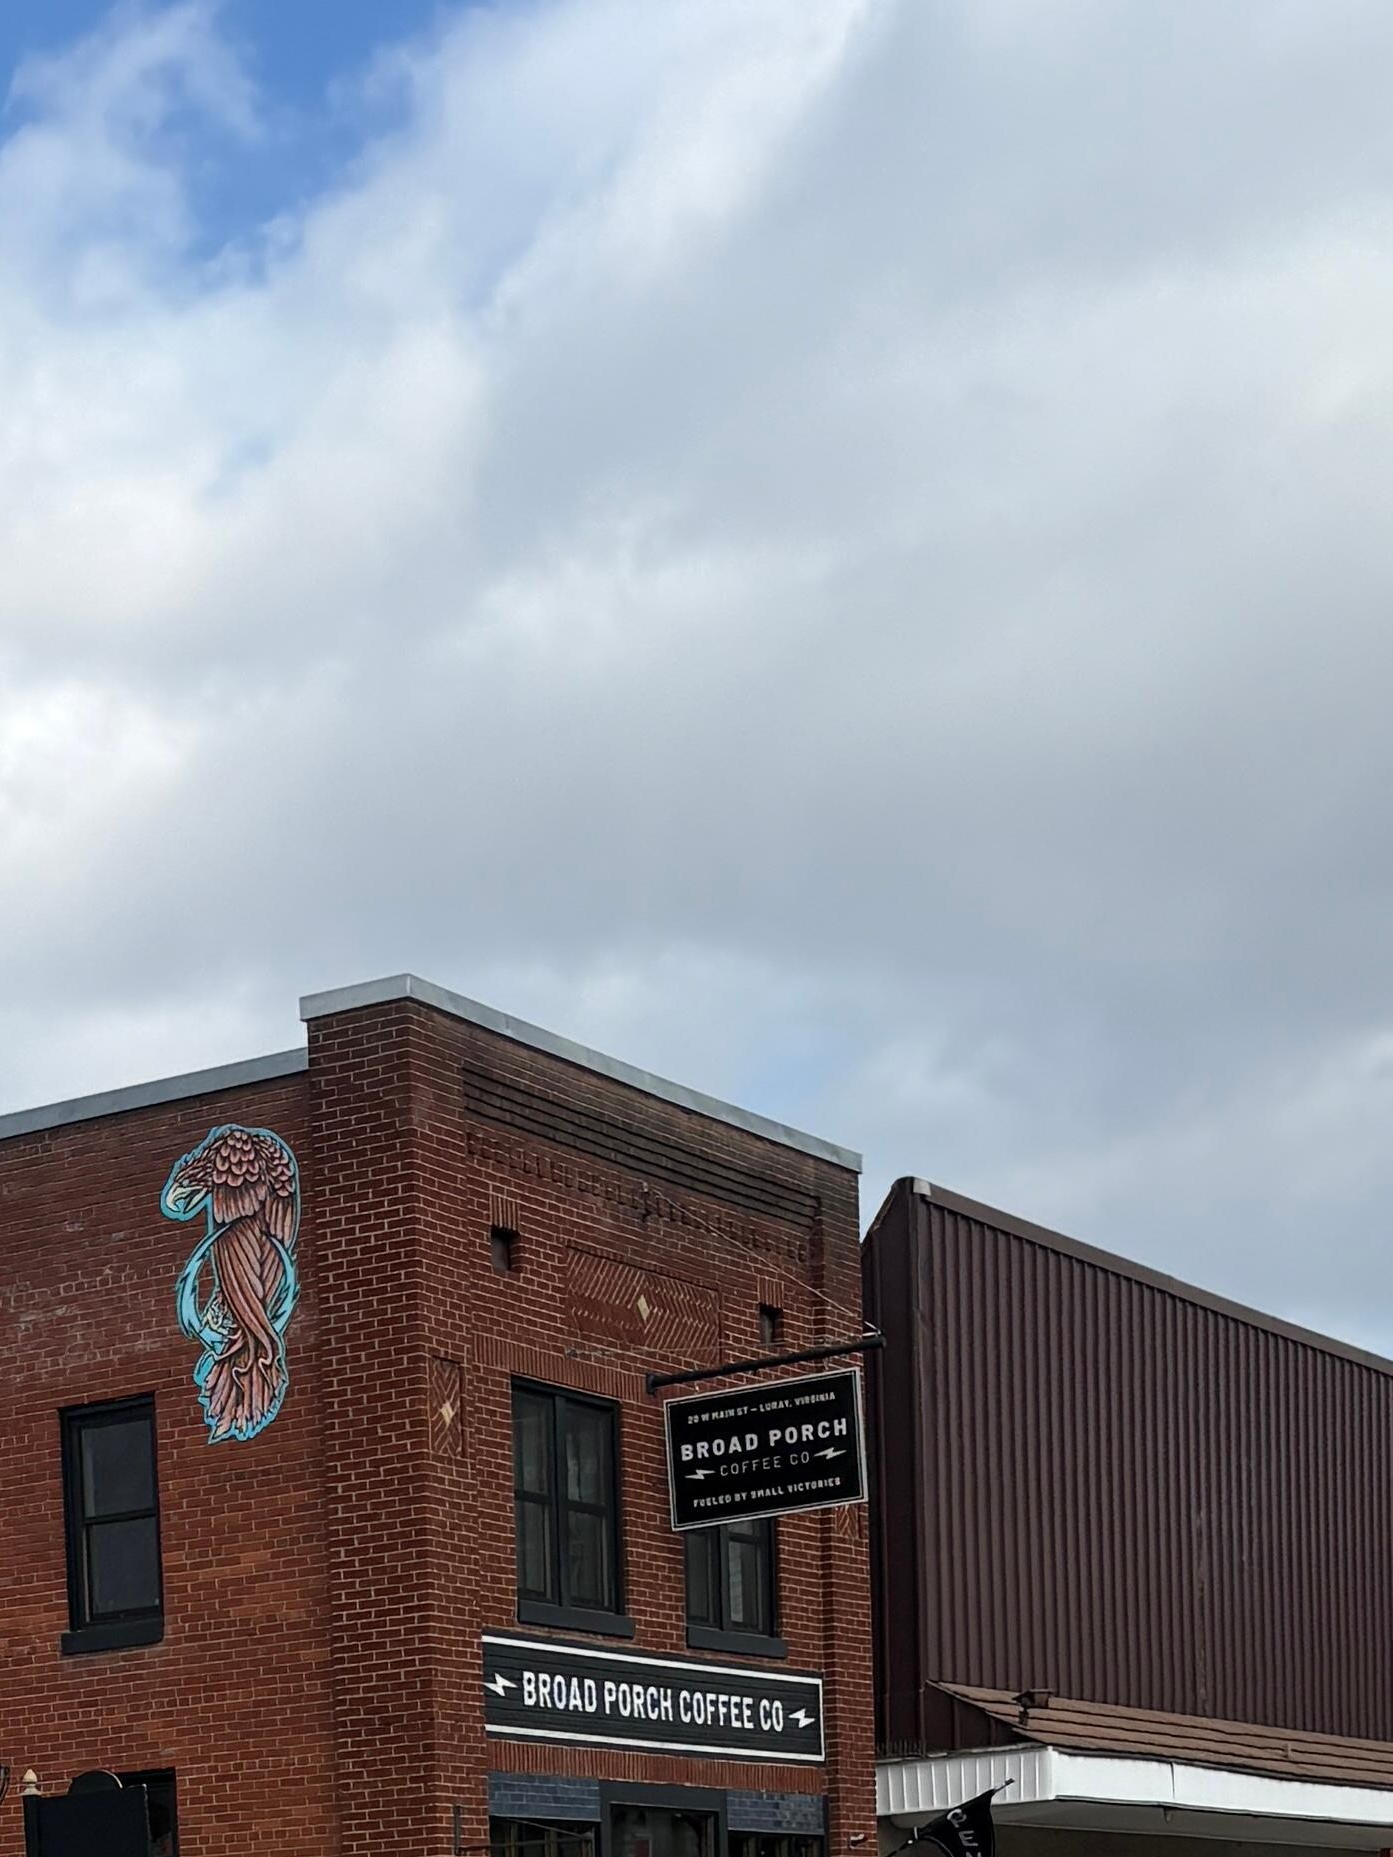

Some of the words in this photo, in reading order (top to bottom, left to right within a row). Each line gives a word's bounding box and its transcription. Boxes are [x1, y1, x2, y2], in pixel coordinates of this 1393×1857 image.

[711, 1408, 735, 1420] MAIN
[736, 1406, 748, 1416] ST
[794, 1391, 836, 1406] VIRGINIA
[681, 1433, 758, 1461] BROAD
[769, 1418, 847, 1447] PORCH
[720, 1455, 782, 1476] COFFEE
[789, 1451, 810, 1465] CO
[693, 1494, 732, 1508] FUELED
[734, 1491, 748, 1502] BY
[750, 1486, 784, 1499] SMALL
[787, 1477, 841, 1493] VICTORIES
[522, 1670, 597, 1713] BROAD
[604, 1680, 673, 1722] PORCH
[679, 1690, 754, 1729] COFFEE
[759, 1699, 783, 1732] CO
